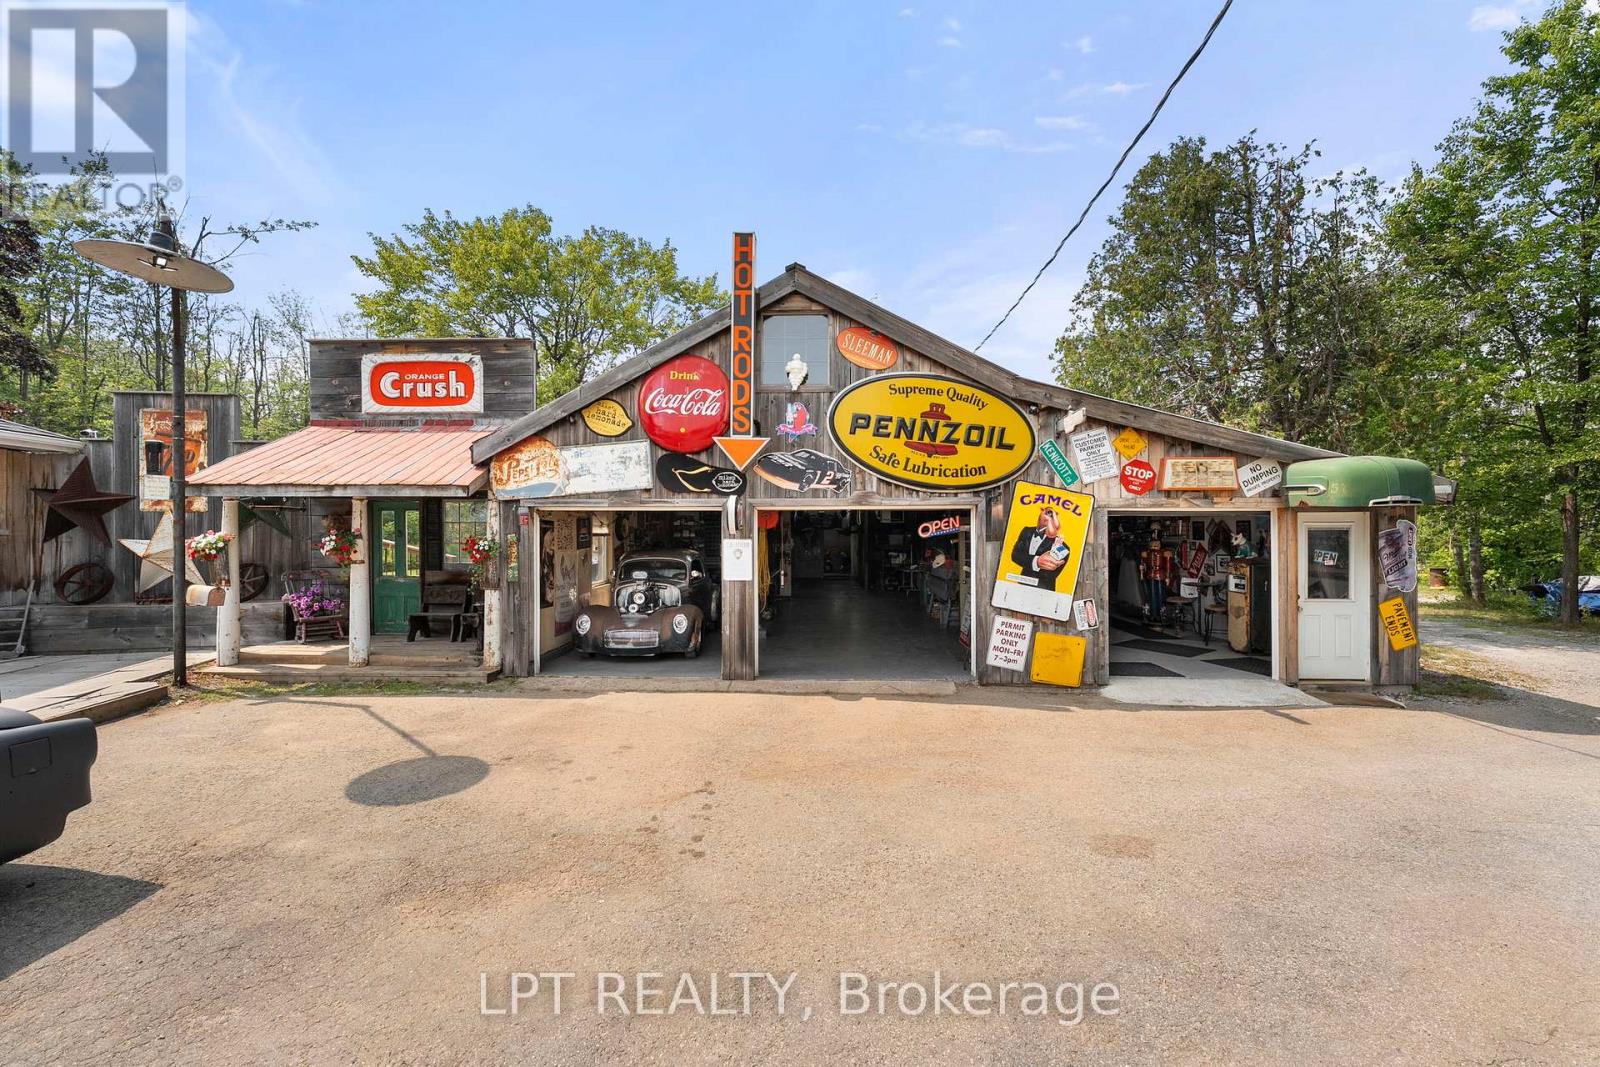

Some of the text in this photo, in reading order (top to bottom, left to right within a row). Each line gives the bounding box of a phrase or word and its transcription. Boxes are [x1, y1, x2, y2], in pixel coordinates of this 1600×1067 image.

[733, 236, 753, 433] HOT RODS
[843, 333, 893, 364] SLEEMAN
[380, 370, 466, 399] Crush
[670, 371, 700, 381] Drink
[644, 387, 726, 416] Coca-Cola
[888, 383, 988, 411] Supreme Quality
[586, 410, 626, 428] lemonade
[596, 408, 617, 419] hard
[849, 413, 1016, 451] PENNZOIL
[1075, 435, 1107, 449] CUSTOMER
[1079, 442, 1106, 453] PARKING
[1086, 448, 1101, 457] ONLY
[869, 445, 901, 468] Safe
[903, 458, 987, 478] Lubrication
[1043, 442, 1072, 478] KENICOTT
[1249, 463, 1262, 475] NO
[1124, 466, 1154, 480] STOP
[1242, 466, 1279, 488] DUMPING
[1262, 474, 1281, 486] PROPERTY
[1020, 493, 1082, 517] CAMEL
[917, 515, 960, 538] OPEN
[1000, 621, 1025, 629] PERMIT
[1385, 615, 1400, 637] ENDS
[1392, 602, 1415, 642] PAVEMENT
[995, 628, 1027, 641] PARKING
[1000, 638, 1019, 648] ONLY
[992, 645, 1024, 656] MON-FRI
